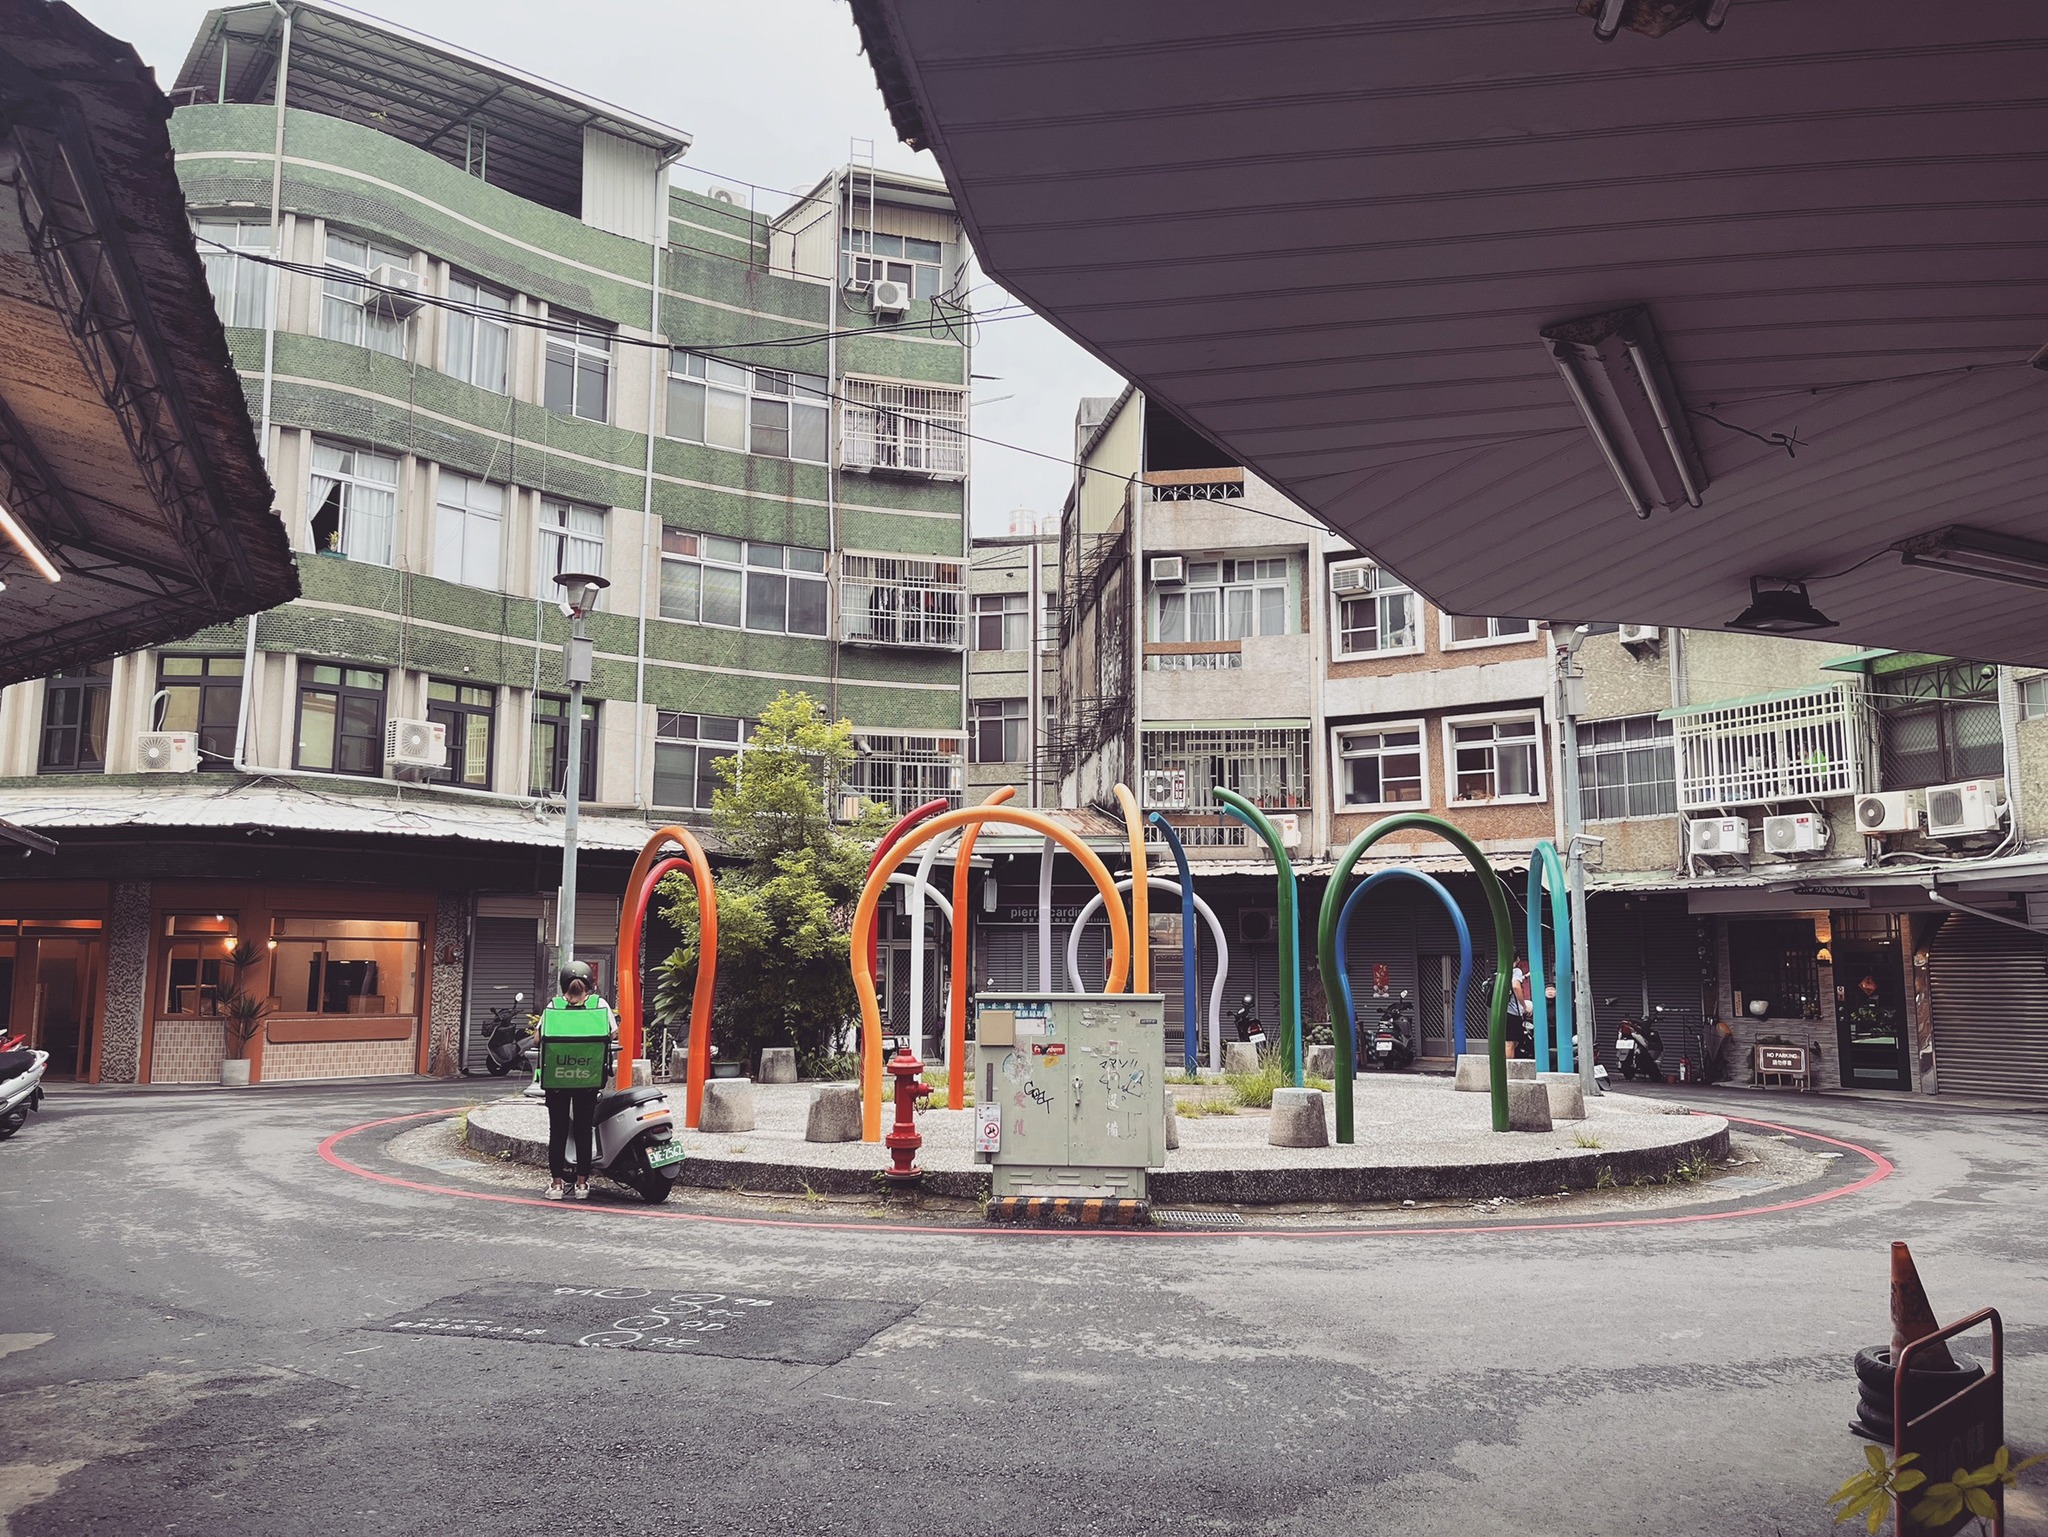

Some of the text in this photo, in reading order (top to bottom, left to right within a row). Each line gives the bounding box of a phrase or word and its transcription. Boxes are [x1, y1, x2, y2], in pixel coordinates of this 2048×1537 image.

[1010, 906, 1040, 918] pierr
[1033, 1045, 1063, 1053] frdom
[556, 1054, 592, 1066] Uber
[554, 1067, 591, 1079] Eats
